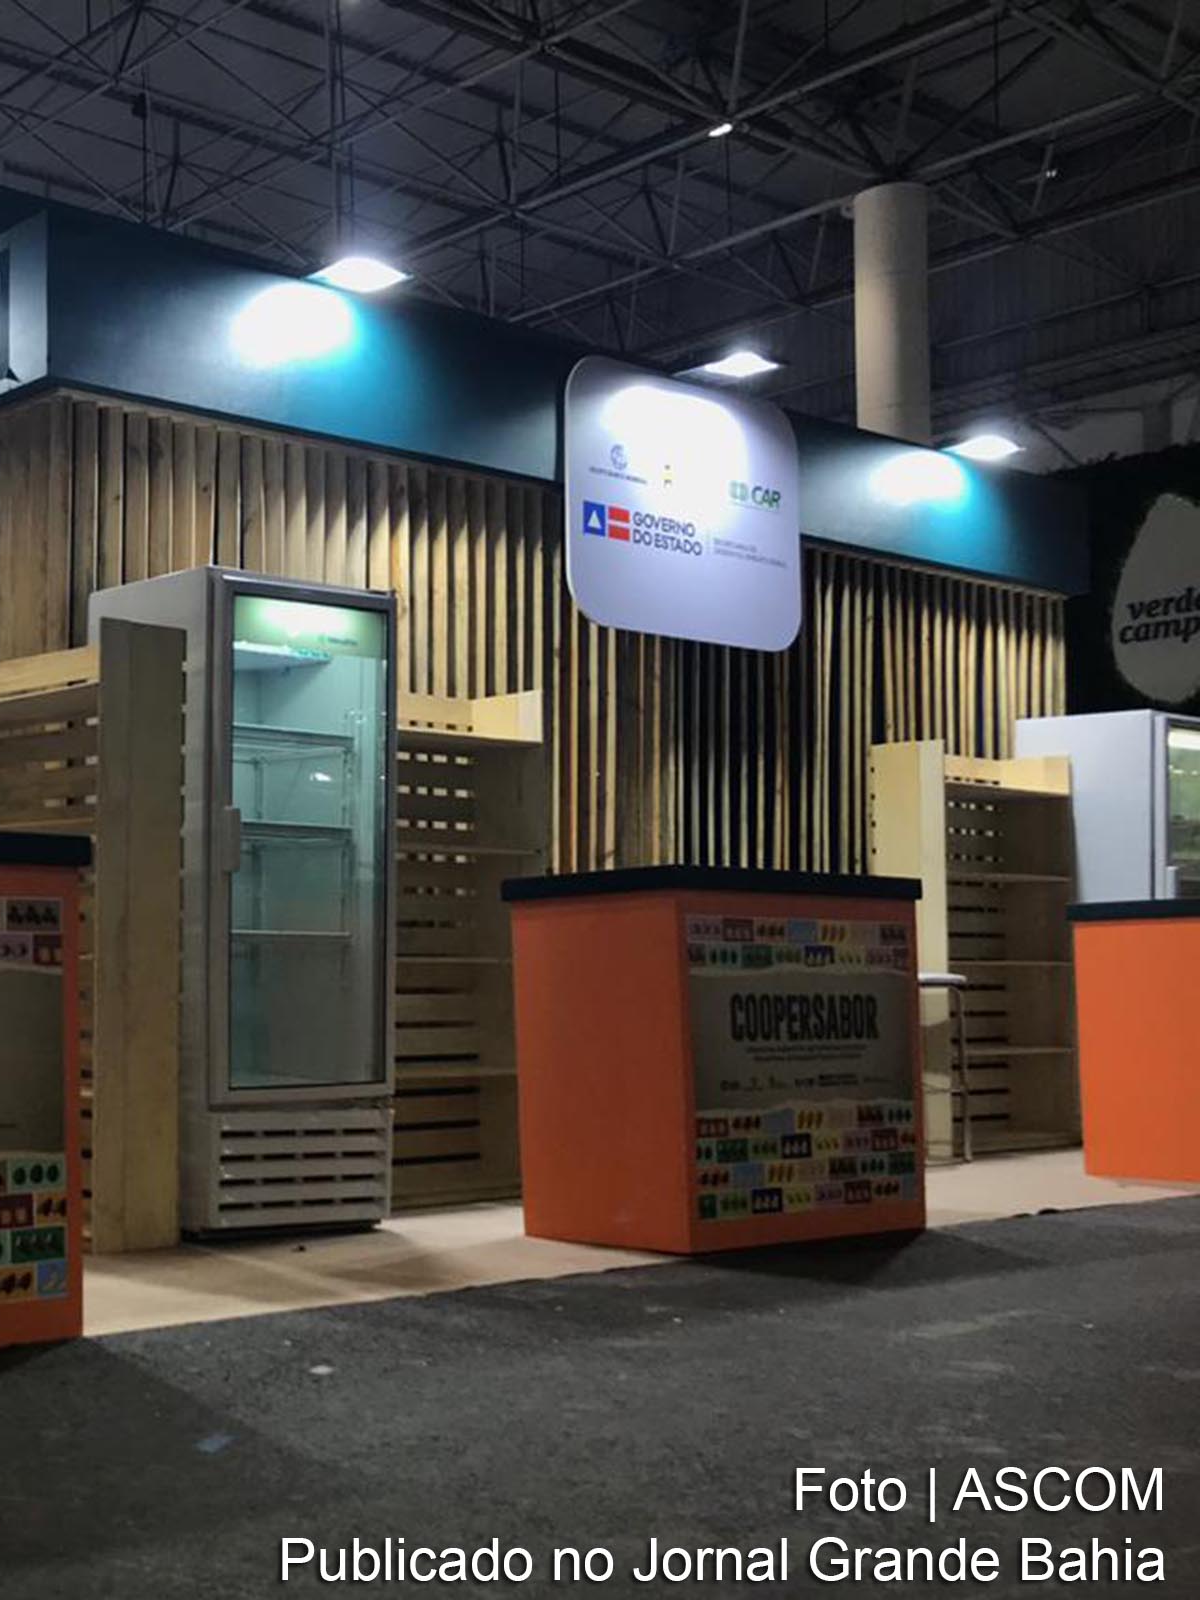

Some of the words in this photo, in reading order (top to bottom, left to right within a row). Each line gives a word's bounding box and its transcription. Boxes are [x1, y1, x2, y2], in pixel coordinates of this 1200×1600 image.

[751, 485, 782, 510] CAR
[632, 511, 696, 538] GOVERNO
[632, 529, 652, 547] DO
[653, 534, 703, 557] ESTADO
[729, 993, 880, 1042] COOPERSABOR
